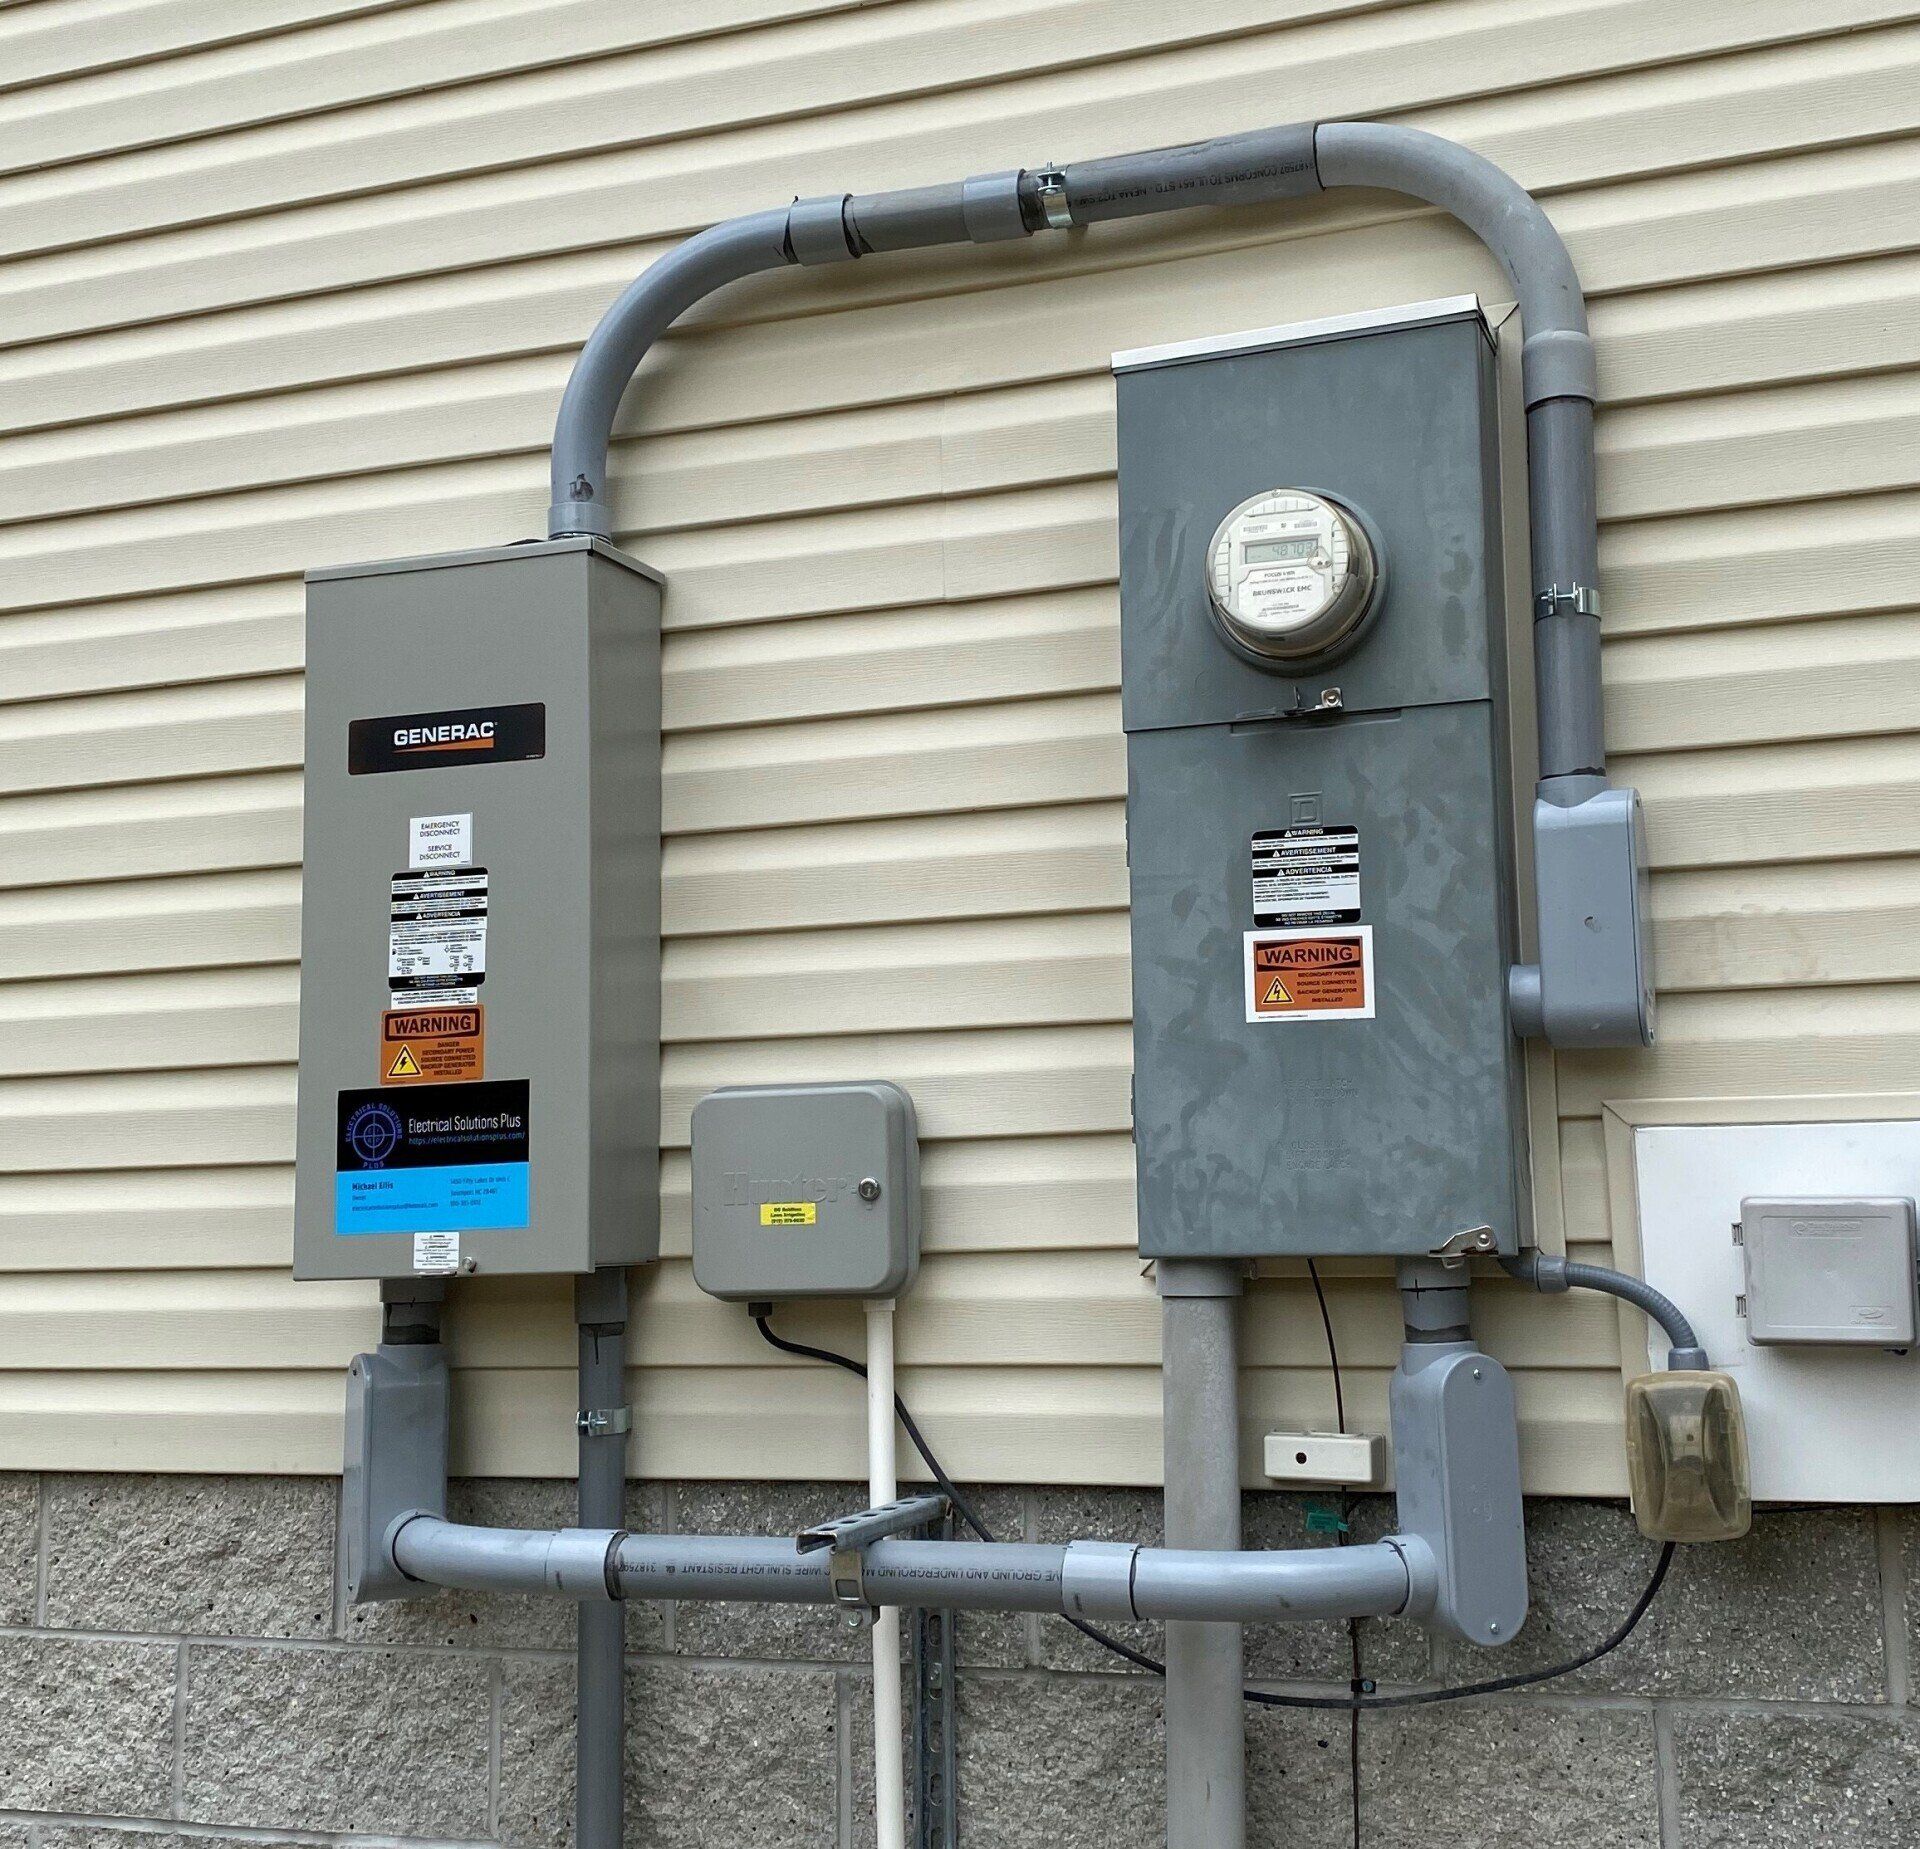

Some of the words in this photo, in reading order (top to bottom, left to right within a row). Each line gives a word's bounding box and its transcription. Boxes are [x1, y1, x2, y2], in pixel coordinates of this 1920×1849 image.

[1209, 173, 1222, 186] TO
[1225, 165, 1278, 184] CONFORMS
[1118, 187, 1147, 198] NEMA
[1252, 586, 1296, 597] BRUNSWICK
[1297, 584, 1312, 592] EMC
[393, 721, 495, 747] GENERAC
[421, 820, 460, 830] EMERGENCY
[419, 828, 461, 838] DISCONNECT
[1291, 828, 1324, 836] WARNING
[427, 844, 453, 852] SERVICE
[1280, 846, 1337, 857] AVERTISSEMENT
[419, 851, 461, 861] DISCONNECT
[429, 869, 456, 877] WARNING
[1285, 866, 1333, 876] ADVERTENCIA
[1264, 946, 1353, 964] WARNING
[394, 1014, 471, 1035] WARNING
[422, 1048, 454, 1056] SECONDARY
[444, 1054, 476, 1062] CONNECTED
[421, 1062, 443, 1070] BACKUP
[444, 1061, 476, 1069] GENERATOR
[345, 1103, 376, 1143] ELECTRICAL
[408, 1117, 453, 1134] Electrical
[454, 1115, 499, 1131] Solutions
[500, 1113, 521, 1128] Plus
[362, 1160, 385, 1169] PLUS
[352, 1182, 378, 1191] Michael
[379, 1181, 394, 1190] Ellis
[682, 1562, 738, 1575] RESISTANT
[740, 1563, 792, 1576] SUNLIGHT
[794, 1564, 822, 1576] WIRE
[861, 1565, 875, 1577] MA
[878, 1565, 964, 1579] UNDERGROUND
[966, 1567, 989, 1580] AND
[992, 1568, 1042, 1581] GROUND
[1045, 1569, 1062, 1582] VE
